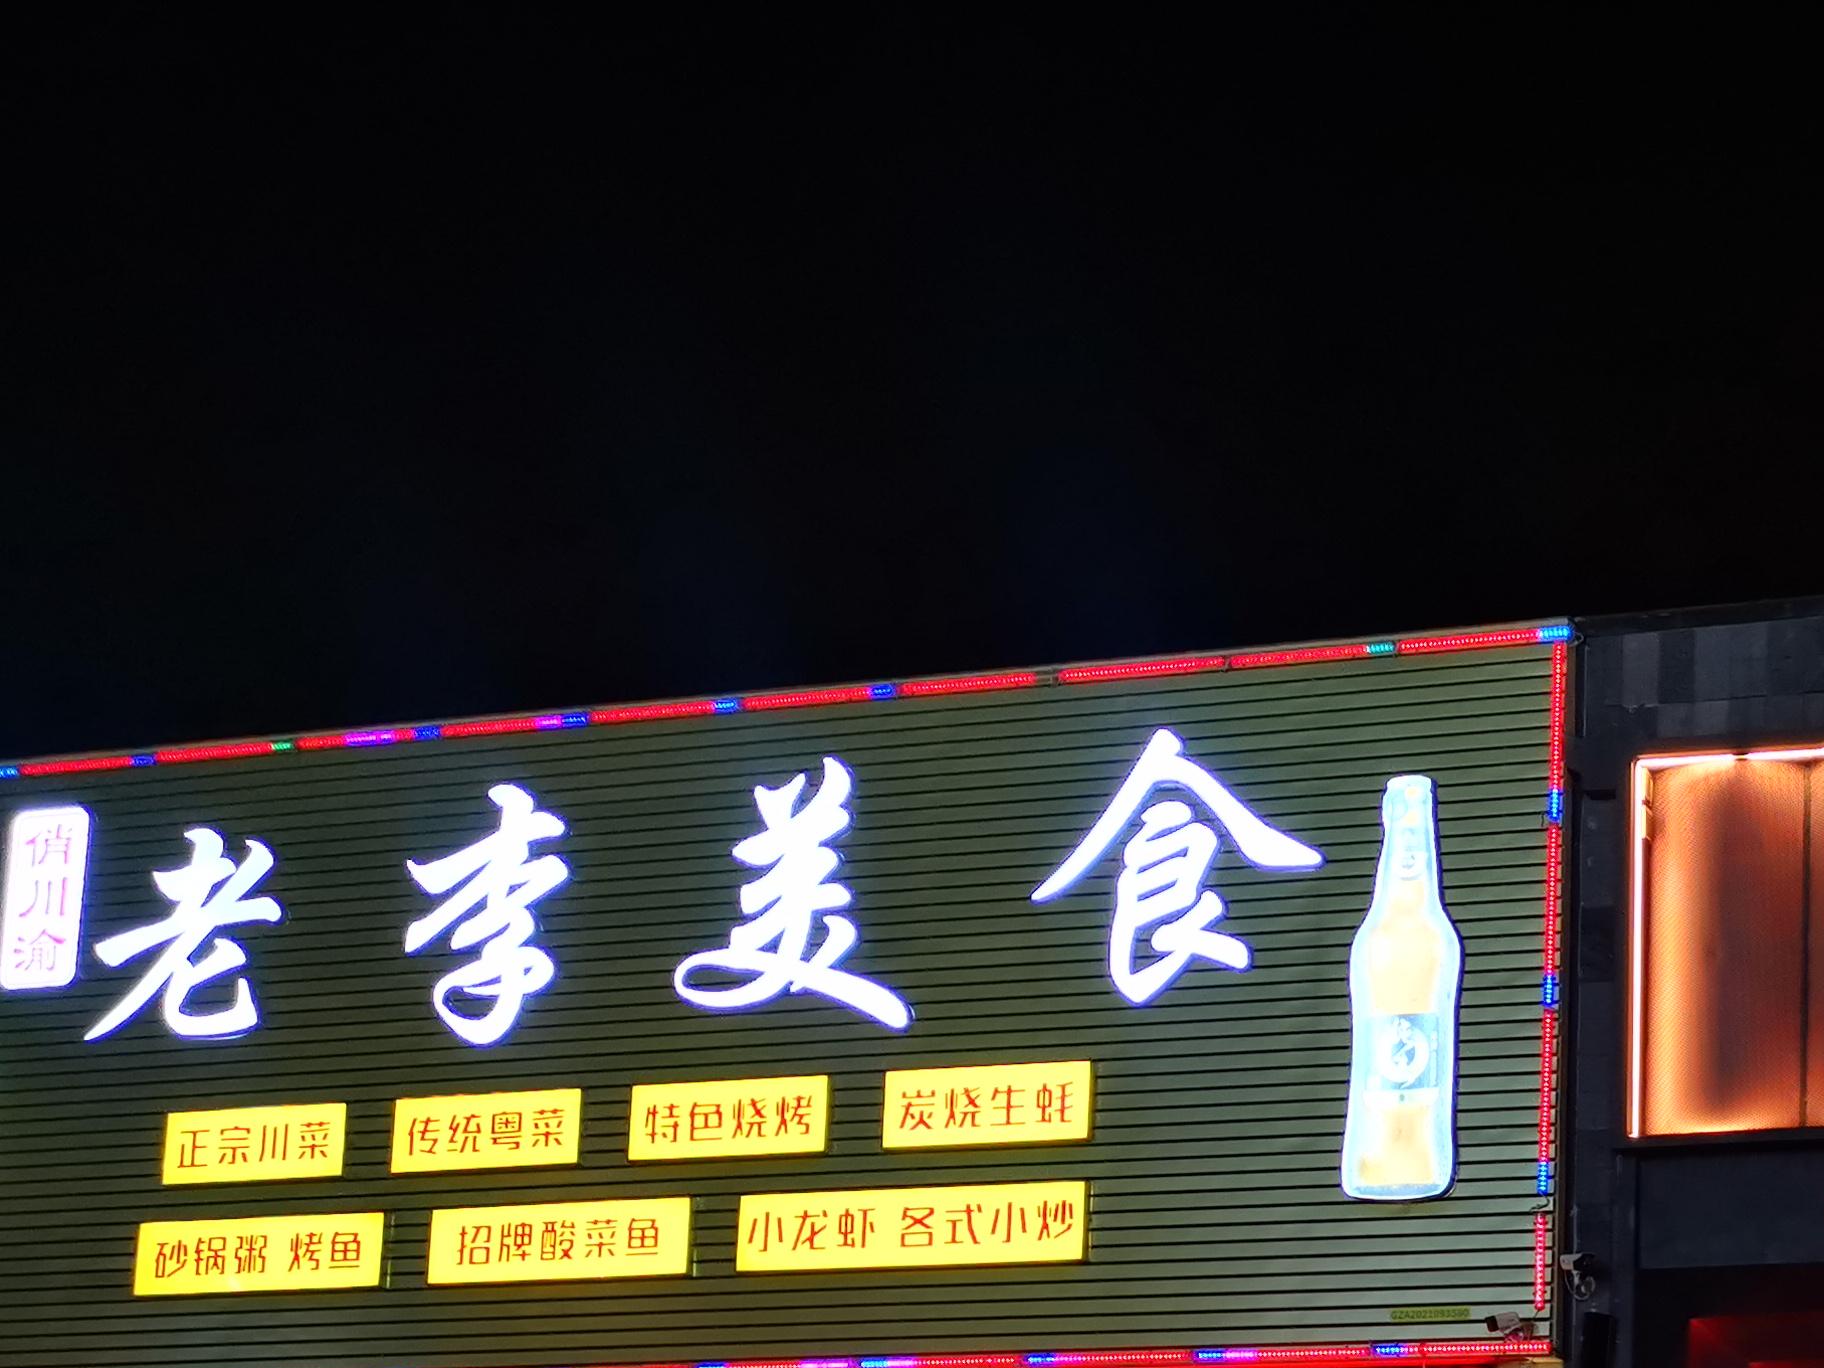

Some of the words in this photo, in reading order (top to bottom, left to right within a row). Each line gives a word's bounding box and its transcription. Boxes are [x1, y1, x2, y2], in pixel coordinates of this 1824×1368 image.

[83, 727, 1326, 1047] 老李美食
[645, 1094, 814, 1144] 特色烧烤
[899, 1078, 1075, 1132] 炭烧生蚝
[176, 1119, 331, 1170] 正宗川菜
[408, 1107, 566, 1157] 传统粤菜
[457, 1218, 661, 1266] 招牌酸菜鱼
[748, 1207, 877, 1252] 小龙虾
[899, 1199, 1075, 1247] 各式小炒
[153, 1233, 269, 1280] 砂锅粥
[290, 1230, 362, 1271] 烤鱼
